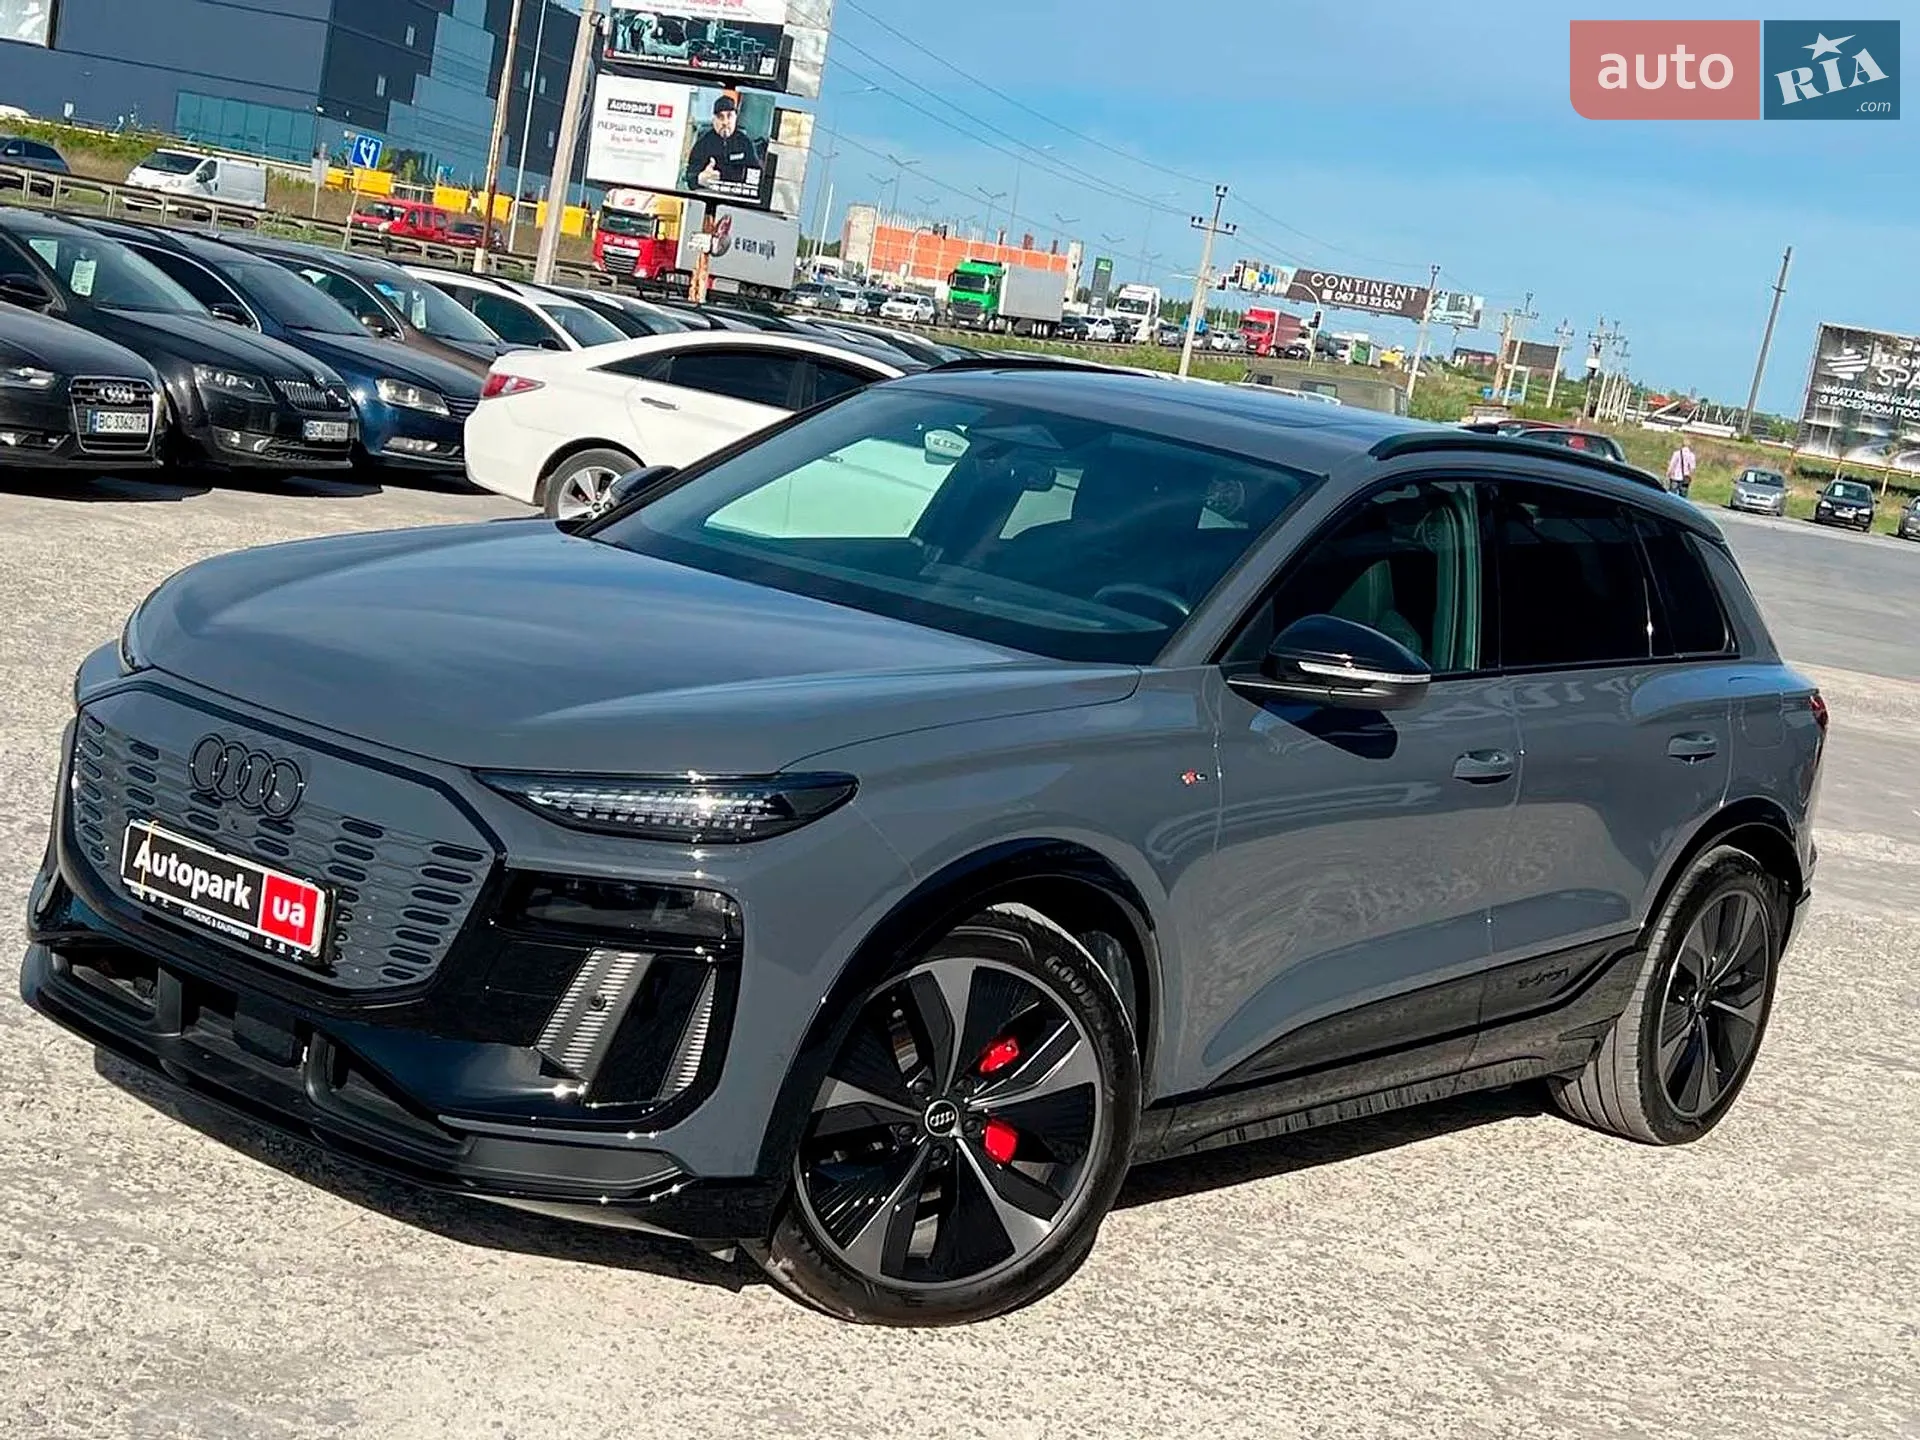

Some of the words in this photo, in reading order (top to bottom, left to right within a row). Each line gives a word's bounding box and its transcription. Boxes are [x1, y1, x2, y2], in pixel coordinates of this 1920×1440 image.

[609, 99, 653, 114] Autopark
[742, 238, 757, 254] van
[1310, 272, 1418, 302] CONTINENT
[1334, 291, 1354, 302] 067
[1829, 396, 1894, 415] БАСЕЙНОМ
[133, 839, 252, 910] Autopark
[272, 896, 305, 929] ua
